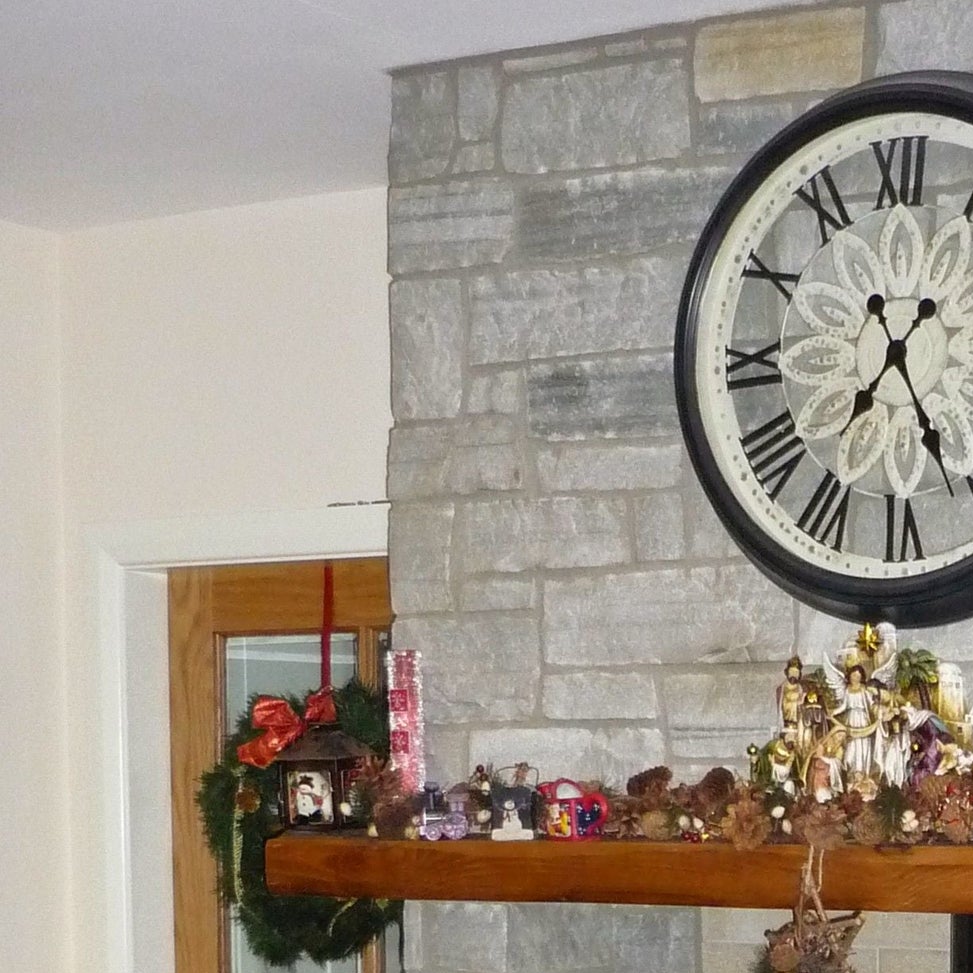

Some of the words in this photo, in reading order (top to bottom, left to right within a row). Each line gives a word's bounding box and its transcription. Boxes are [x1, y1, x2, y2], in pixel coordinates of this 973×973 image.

[792, 165, 854, 248] XI
[869, 135, 929, 211] XII
[740, 248, 803, 306] X
[725, 338, 783, 393] IX
